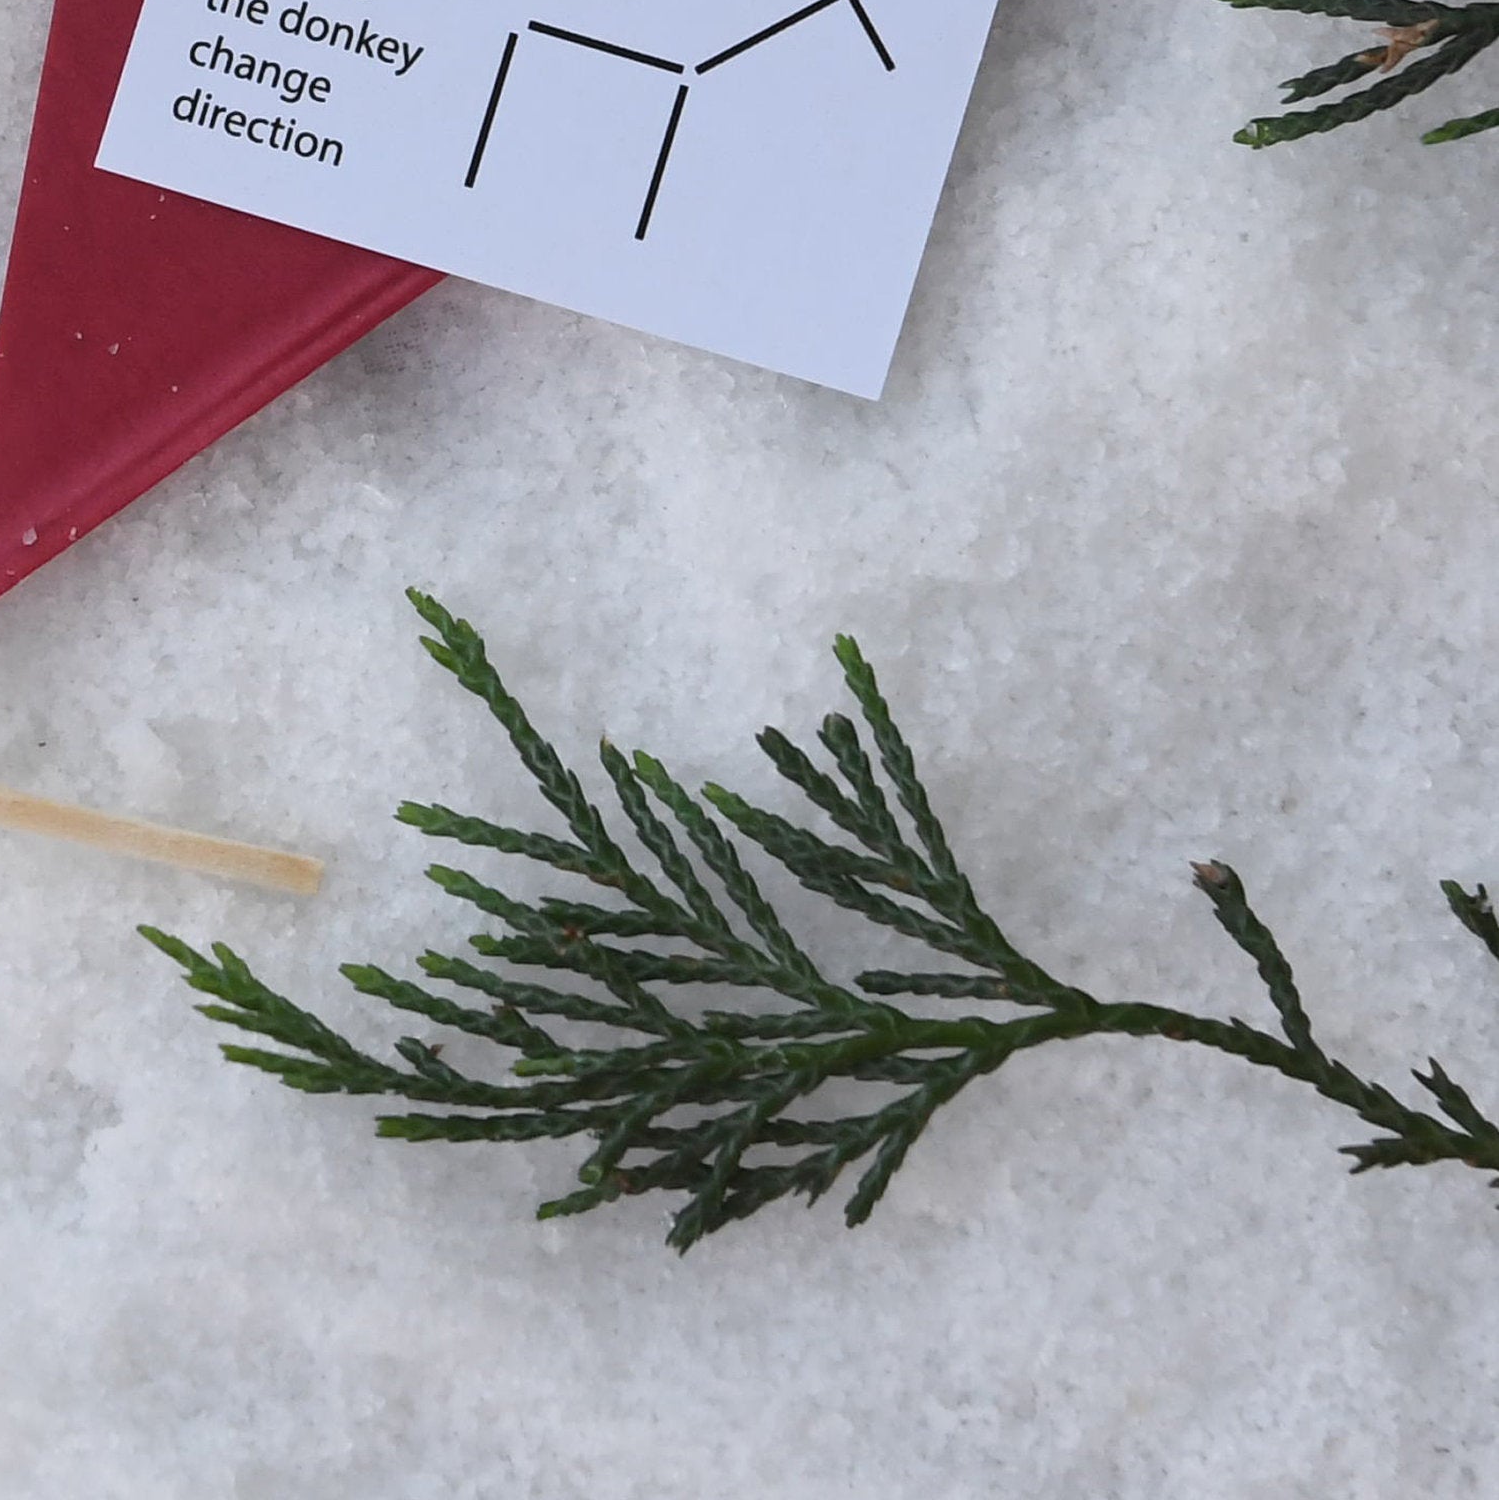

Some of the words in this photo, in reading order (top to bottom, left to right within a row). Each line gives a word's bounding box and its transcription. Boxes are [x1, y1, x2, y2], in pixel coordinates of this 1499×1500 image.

[189, 34, 331, 104] change
[279, 1, 425, 77] donkey
[172, 87, 343, 167] direction
